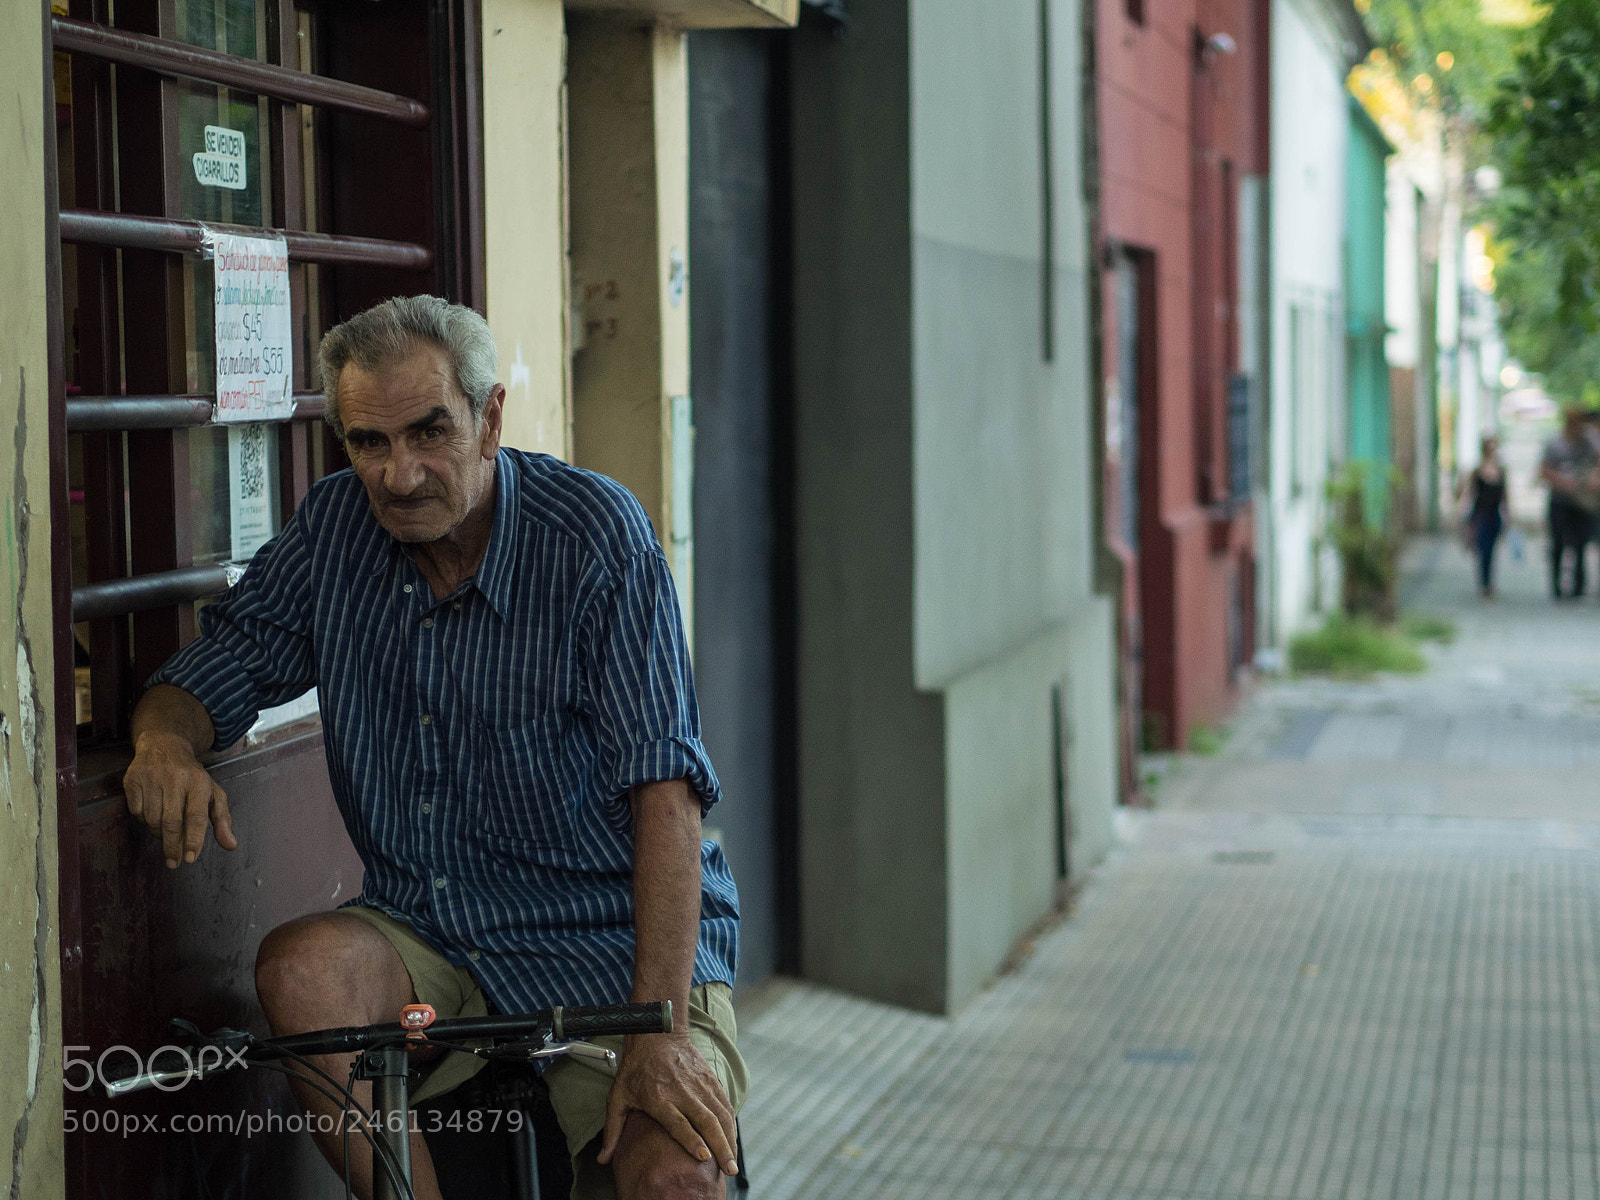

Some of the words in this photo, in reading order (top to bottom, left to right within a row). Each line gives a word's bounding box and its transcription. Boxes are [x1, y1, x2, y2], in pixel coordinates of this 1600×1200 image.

[206, 130, 217, 153] SE
[217, 132, 242, 158] VENDEN
[196, 157, 239, 183] CIGARRILLOS
[243, 312, 263, 343] $45
[263, 347, 283, 376] $55
